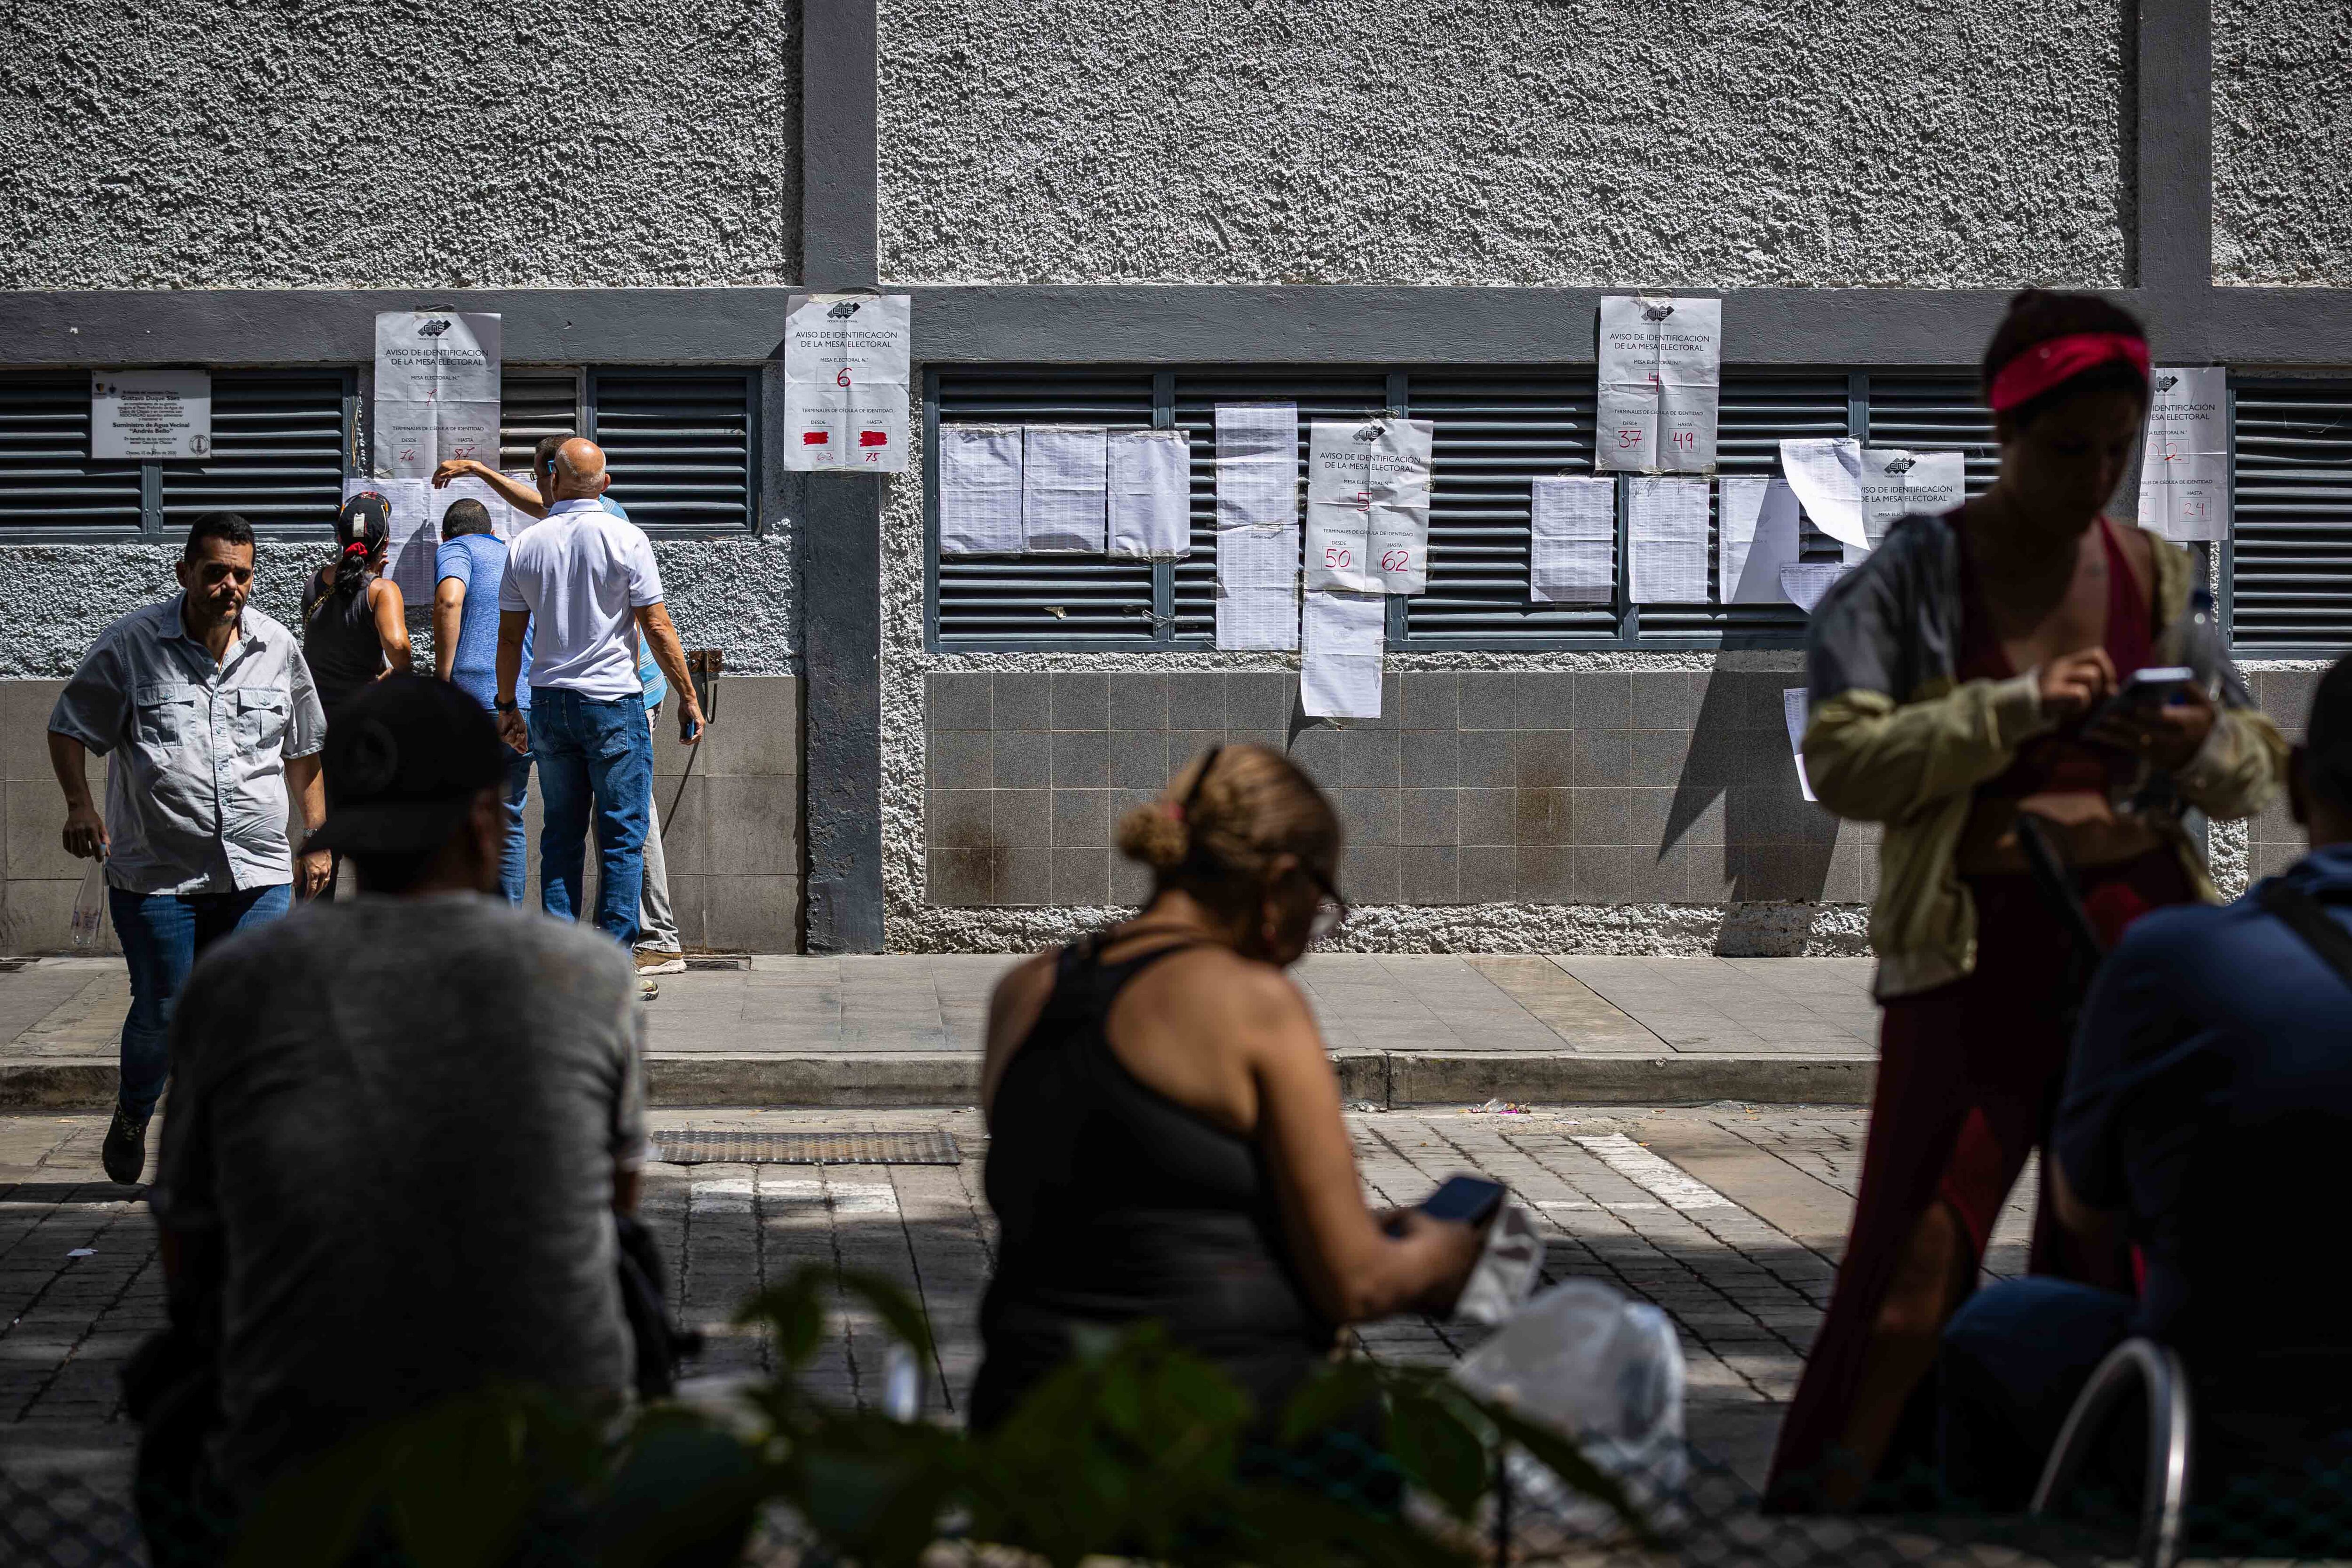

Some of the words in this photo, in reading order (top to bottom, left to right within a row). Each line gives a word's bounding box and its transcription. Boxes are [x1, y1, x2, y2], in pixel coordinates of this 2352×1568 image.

[833, 330, 898, 339] IDENTIFICACIÓN
[1646, 333, 1709, 342] IDENTIFICACIÓN
[423, 348, 488, 356] IDENTIFICACIÓN
[837, 368, 852, 387] 6
[1648, 372, 1659, 392] 4
[425, 389, 437, 406] 7
[2153, 403, 2215, 412] IDENTIFICACIÓN
[1618, 430, 1642, 448] 37
[1673, 432, 1693, 449] 49
[400, 449, 416, 462] 76
[866, 453, 881, 462] 75
[1358, 454, 1420, 463] IDENTIFICACIÓN
[1890, 484, 1953, 493] IDENTIFICACIÓN
[1357, 492, 1373, 511] 5
[2184, 502, 2204, 515] 24
[1325, 548, 1351, 568] 50
[1382, 551, 1409, 572] 62
